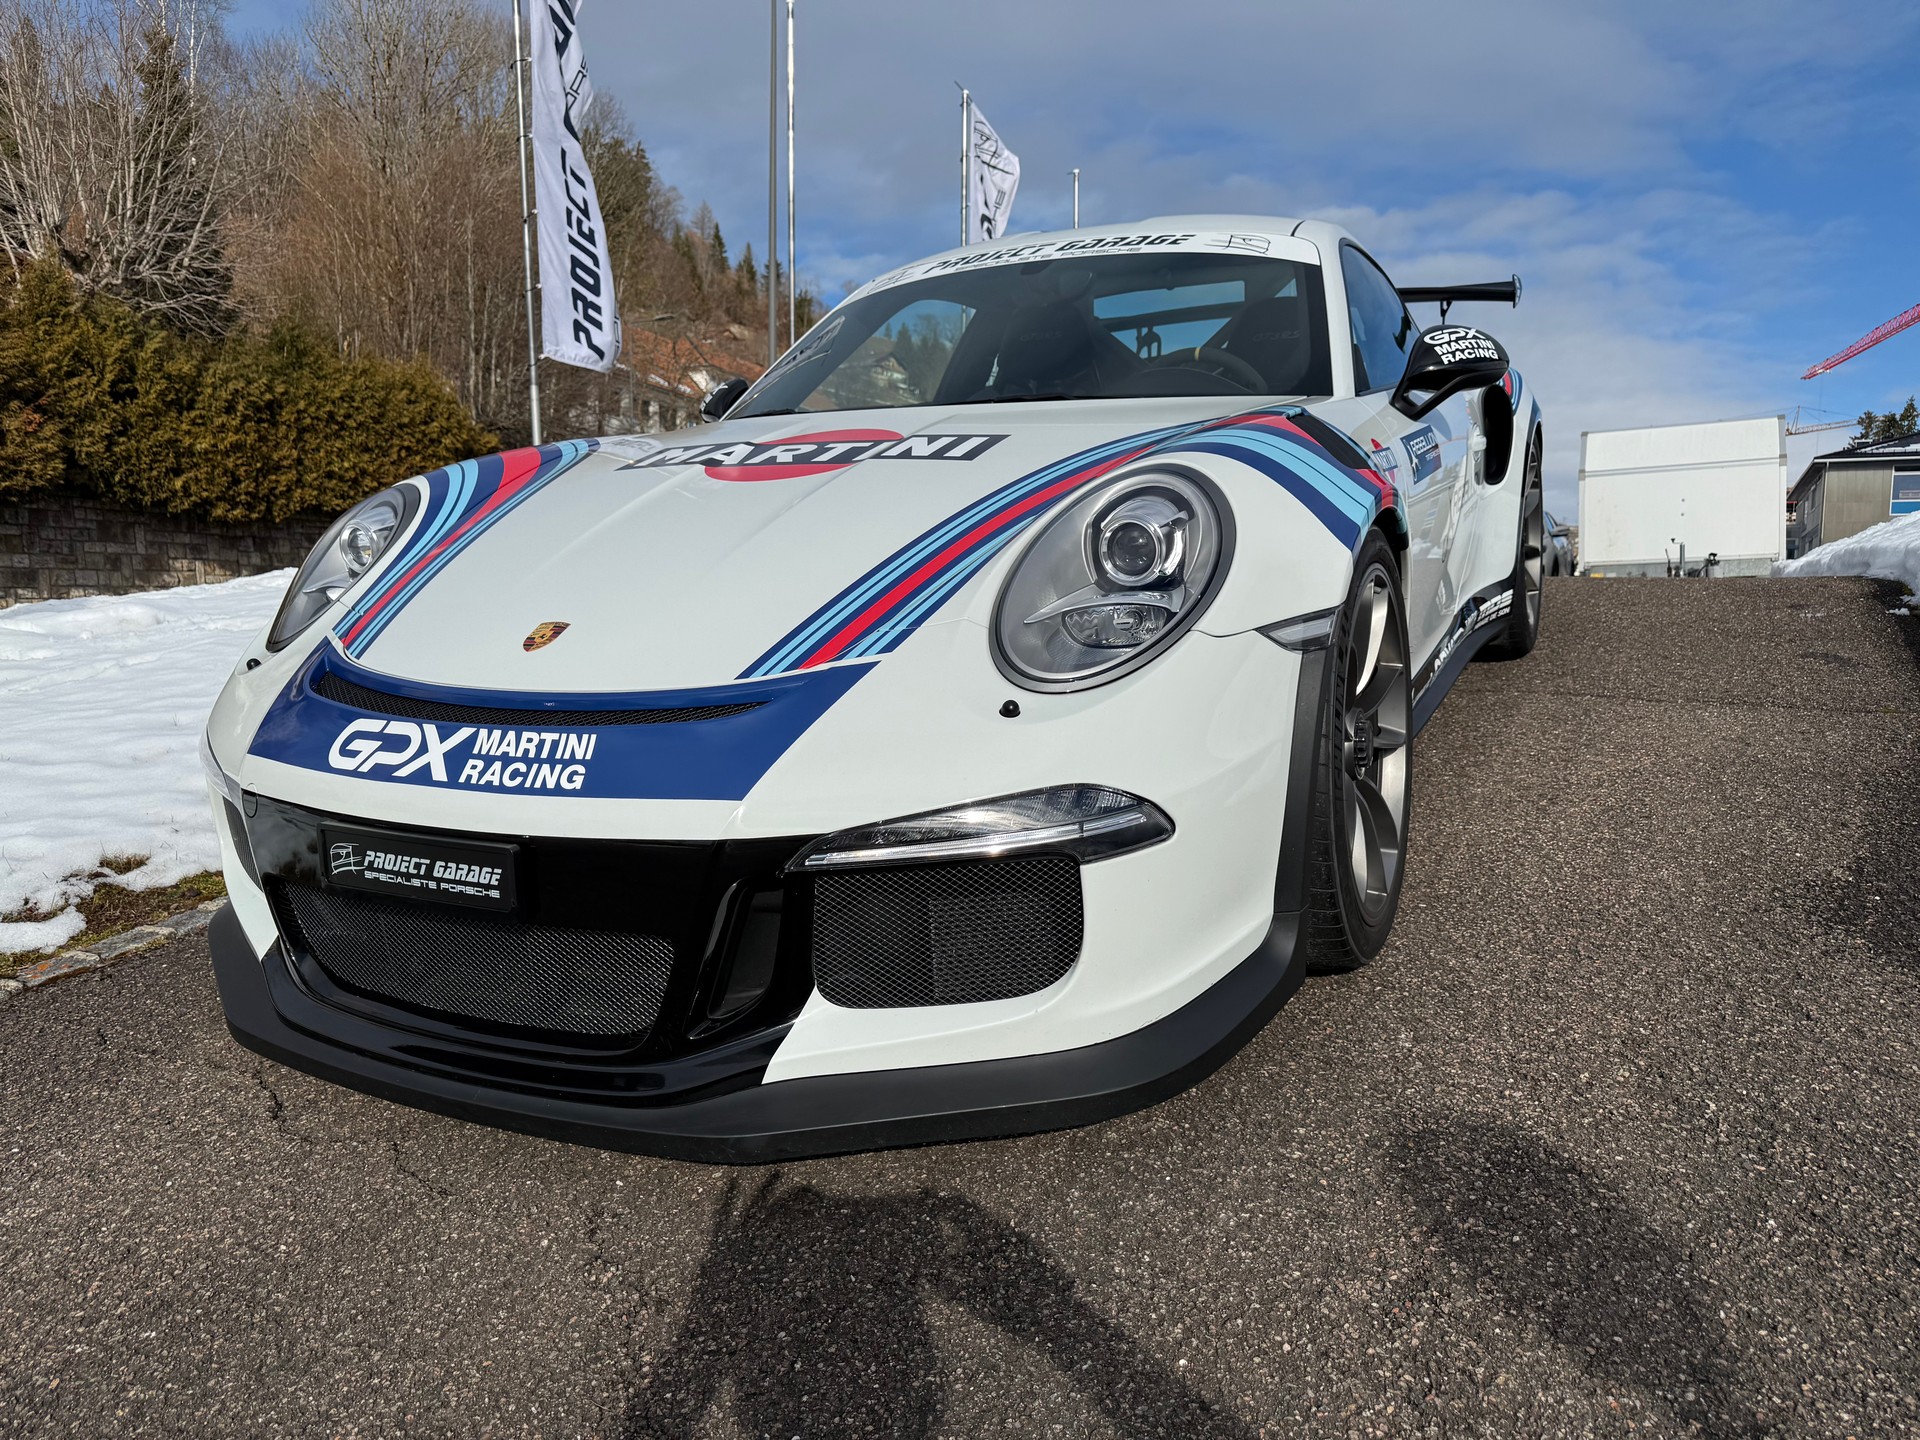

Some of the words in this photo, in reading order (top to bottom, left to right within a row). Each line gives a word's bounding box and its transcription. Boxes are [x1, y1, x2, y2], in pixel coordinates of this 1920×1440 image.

[560, 146, 606, 361] PROJECT
[922, 242, 1058, 275] PROJECT
[1054, 234, 1197, 252] GARAGE
[1060, 247, 1142, 257] PORSCHE
[1423, 327, 1486, 345] GPX
[1433, 339, 1496, 356] MARTINI
[1440, 348, 1499, 365] RACING
[633, 434, 992, 468] MARTINI
[327, 717, 478, 782] GPX
[472, 728, 597, 760] MARTINI
[458, 759, 586, 790] RACING
[363, 850, 430, 876] PROJECT
[432, 861, 502, 886] GARAGE
[364, 870, 437, 889] SPECIALISTE
[440, 882, 501, 898] PORSCHE
